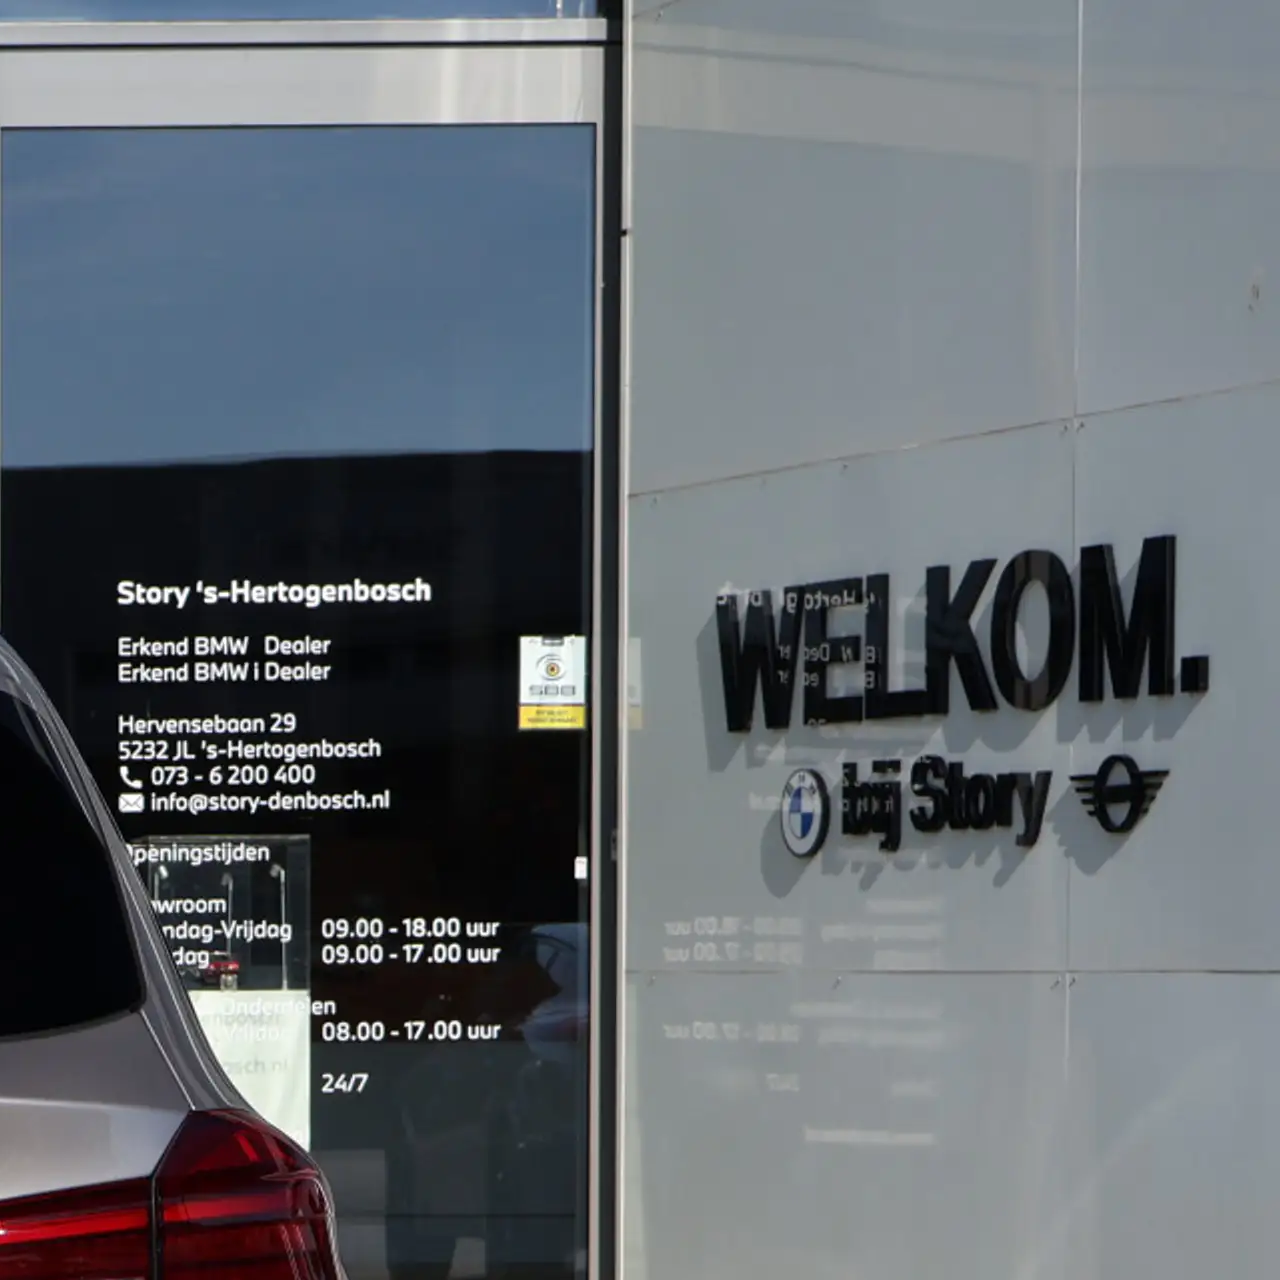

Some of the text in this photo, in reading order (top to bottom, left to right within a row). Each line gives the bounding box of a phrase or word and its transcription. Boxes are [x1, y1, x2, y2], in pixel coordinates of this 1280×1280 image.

[117, 577, 432, 609] Story 's-Hertogenbosch
[715, 534, 1209, 734] WELKOM.
[118, 635, 332, 657] Erkend BMW Dealer
[118, 661, 332, 683] Erkend BMW i Dealer
[118, 712, 297, 735] Hervensebaan 29
[118, 738, 382, 763] 5232 JL 's-Hertogenbosch
[151, 765, 189, 786] 073
[209, 765, 223, 786] 6
[227, 764, 269, 785] 200
[273, 763, 316, 785] 400
[151, 789, 390, 816] info@story-denbosch.nl
[842, 759, 902, 853] bij
[909, 754, 1053, 847] Story
[321, 917, 384, 939] 09.00
[402, 917, 461, 938] 18.00
[465, 921, 500, 938] uur
[321, 943, 384, 965] 09.00
[402, 942, 462, 964] 17.00
[466, 947, 501, 964] uur
[321, 1021, 385, 1042] 08.00
[403, 1019, 462, 1041] 17.00
[467, 1024, 502, 1040] uur
[321, 1072, 369, 1094] 24/7
